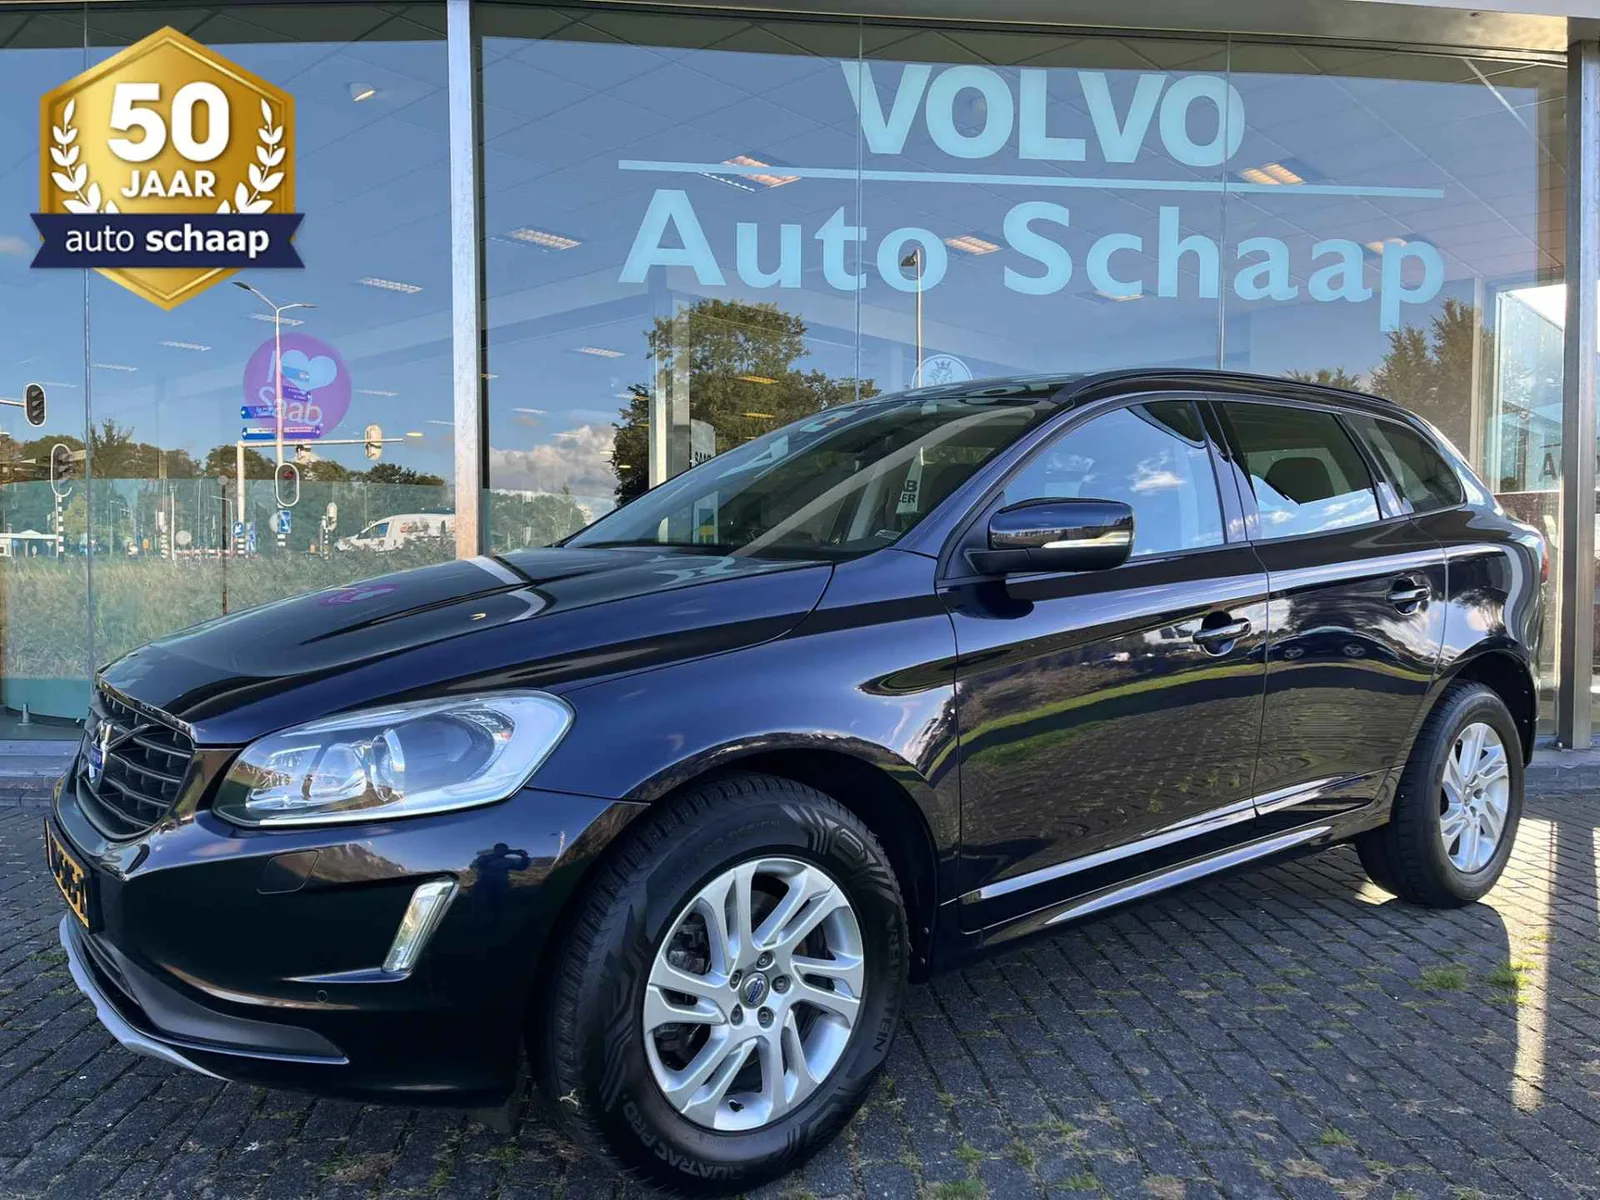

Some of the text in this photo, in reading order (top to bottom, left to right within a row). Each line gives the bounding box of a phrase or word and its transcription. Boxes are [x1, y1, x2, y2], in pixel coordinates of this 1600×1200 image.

[841, 61, 1245, 168] VOLVO
[618, 189, 1445, 333] Auto Schaap
